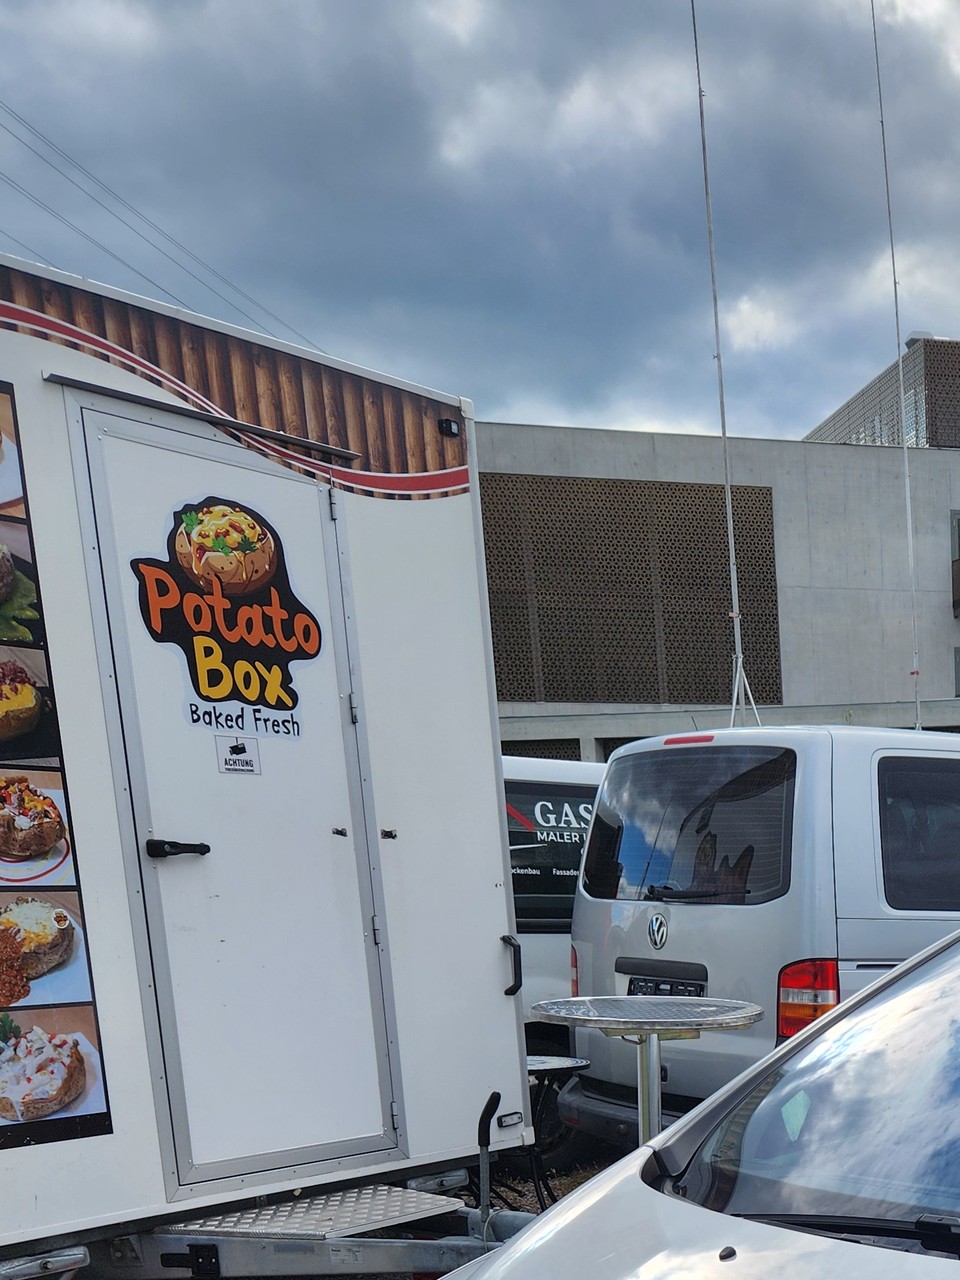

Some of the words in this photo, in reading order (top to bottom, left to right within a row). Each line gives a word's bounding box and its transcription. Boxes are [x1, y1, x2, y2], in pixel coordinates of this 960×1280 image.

[138, 563, 320, 654] Potato
[193, 635, 293, 707] Box
[189, 703, 245, 731] Baked
[252, 708, 300, 737] Fresh
[224, 758, 254, 768] ACHTUNG
[536, 830, 581, 844] MALER
